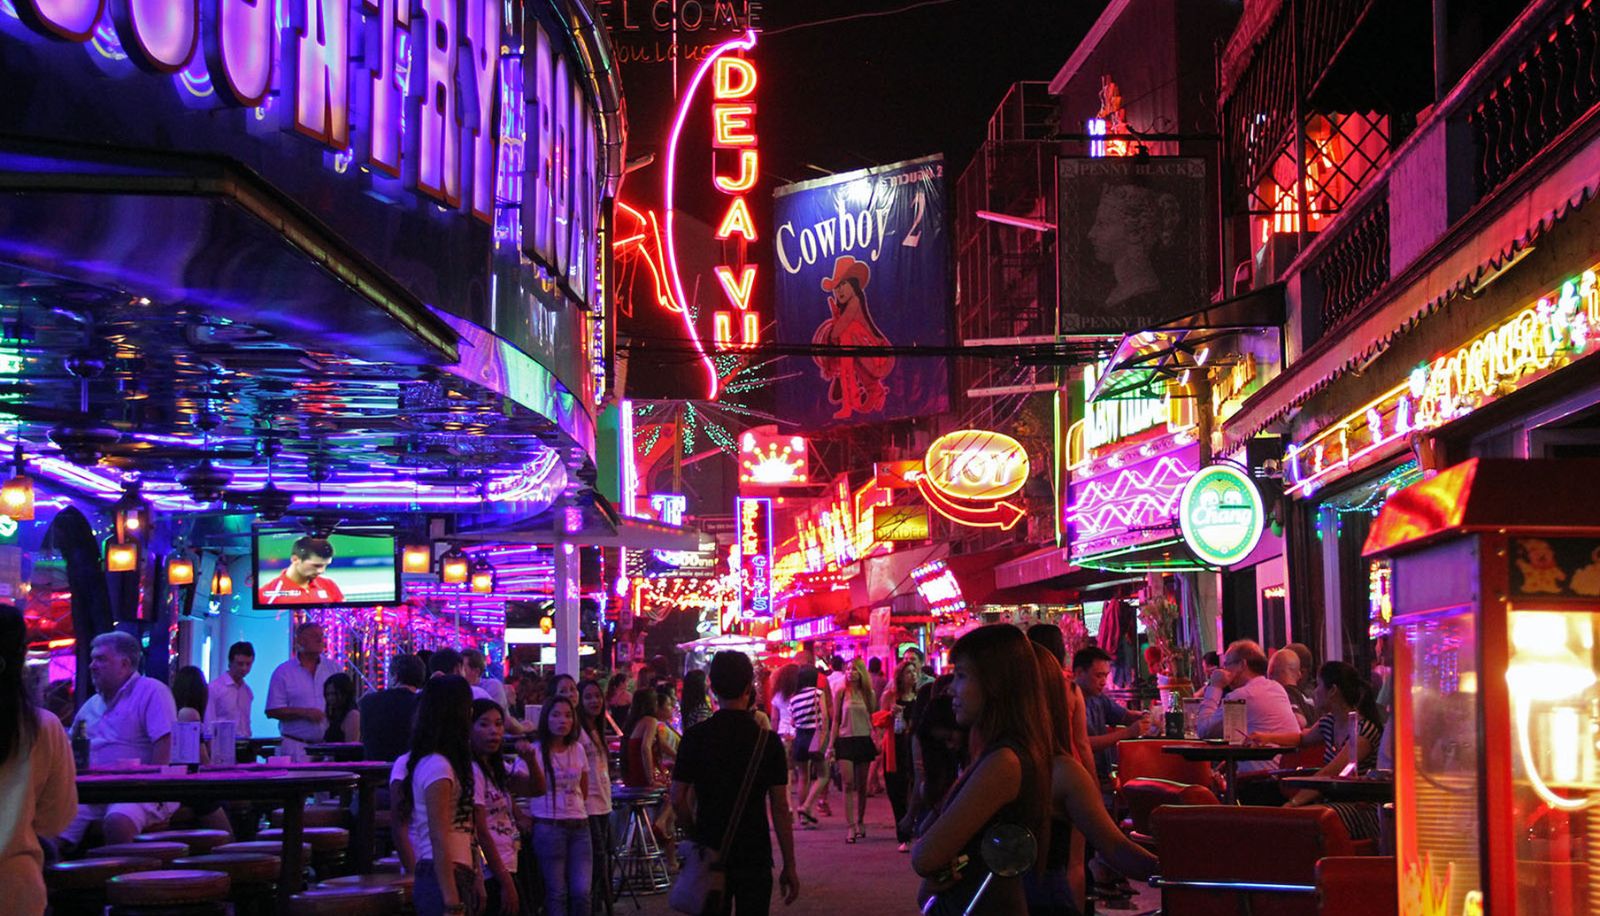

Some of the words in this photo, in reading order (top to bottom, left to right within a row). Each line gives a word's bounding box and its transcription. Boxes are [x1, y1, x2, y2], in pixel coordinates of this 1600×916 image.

[598, 1, 763, 32] ELCOME
[712, 56, 758, 240] DEJA
[1080, 163, 1130, 176] PENNY
[1135, 163, 1187, 176] BLACK
[775, 199, 890, 274] Cowboy
[902, 192, 926, 248] 2
[1080, 316, 1131, 329] PENNY
[939, 449, 1021, 487] TOY
